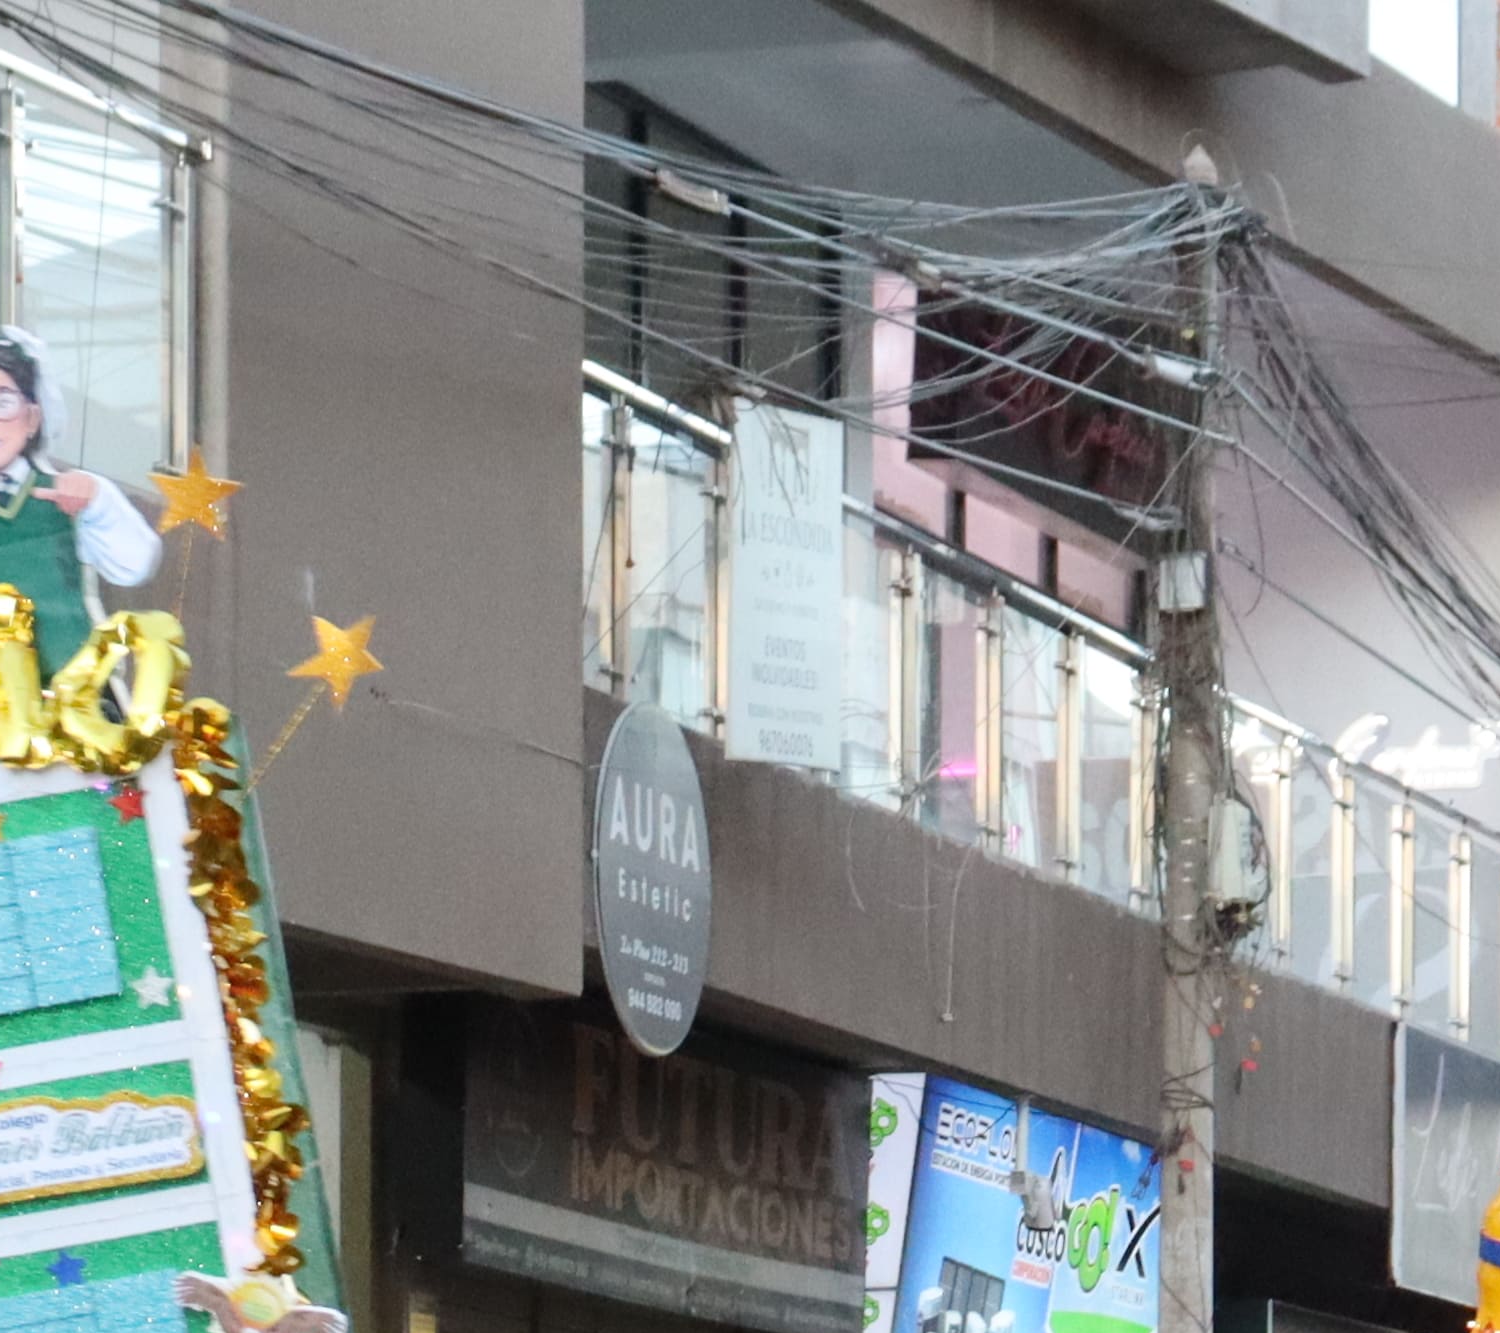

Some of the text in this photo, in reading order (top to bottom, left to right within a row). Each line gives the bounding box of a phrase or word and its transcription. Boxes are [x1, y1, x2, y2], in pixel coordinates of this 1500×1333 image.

[609, 774, 702, 874] AURA
[571, 1022, 856, 1200] FUTURA
[936, 1102, 1016, 1164] ECOFLO
[569, 1138, 853, 1262] IMPORTACIONES
